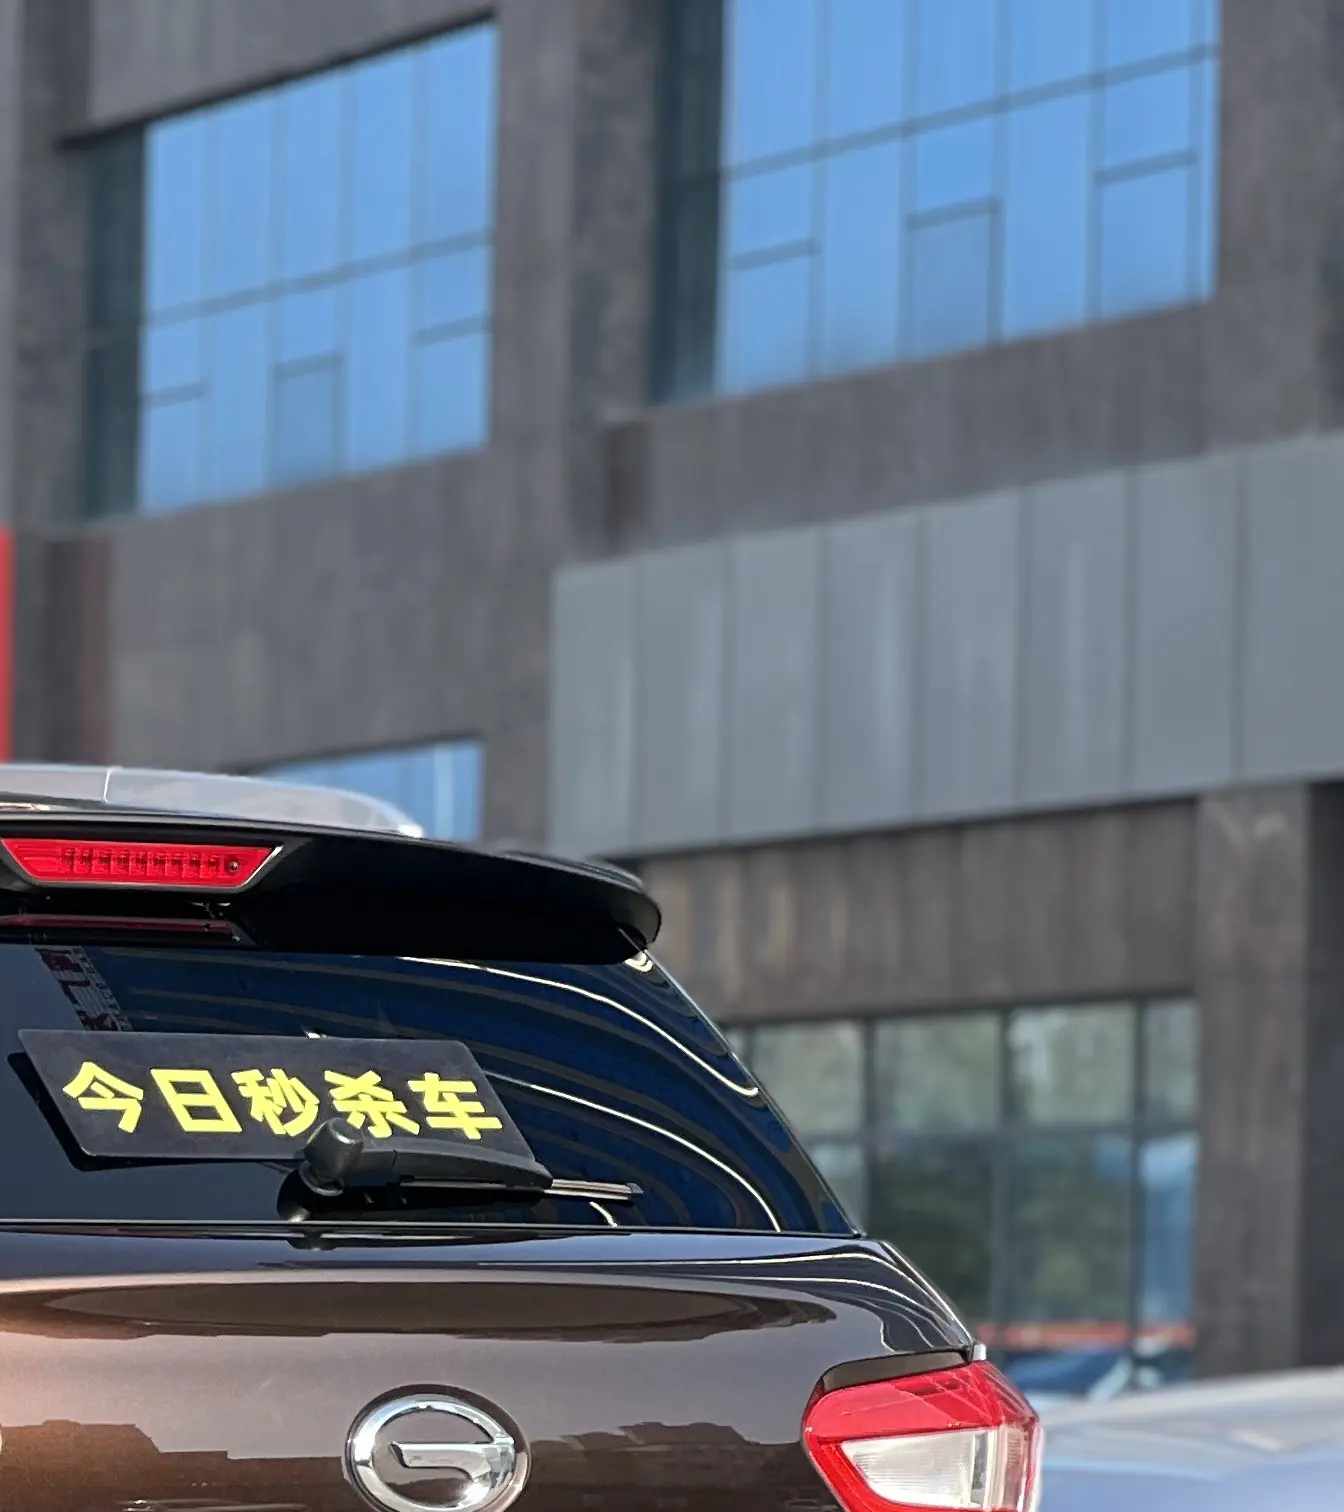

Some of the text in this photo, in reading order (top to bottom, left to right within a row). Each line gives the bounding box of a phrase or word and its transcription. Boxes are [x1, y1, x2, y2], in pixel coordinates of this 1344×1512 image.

[63, 1061, 503, 1141] 今日秒杀车
